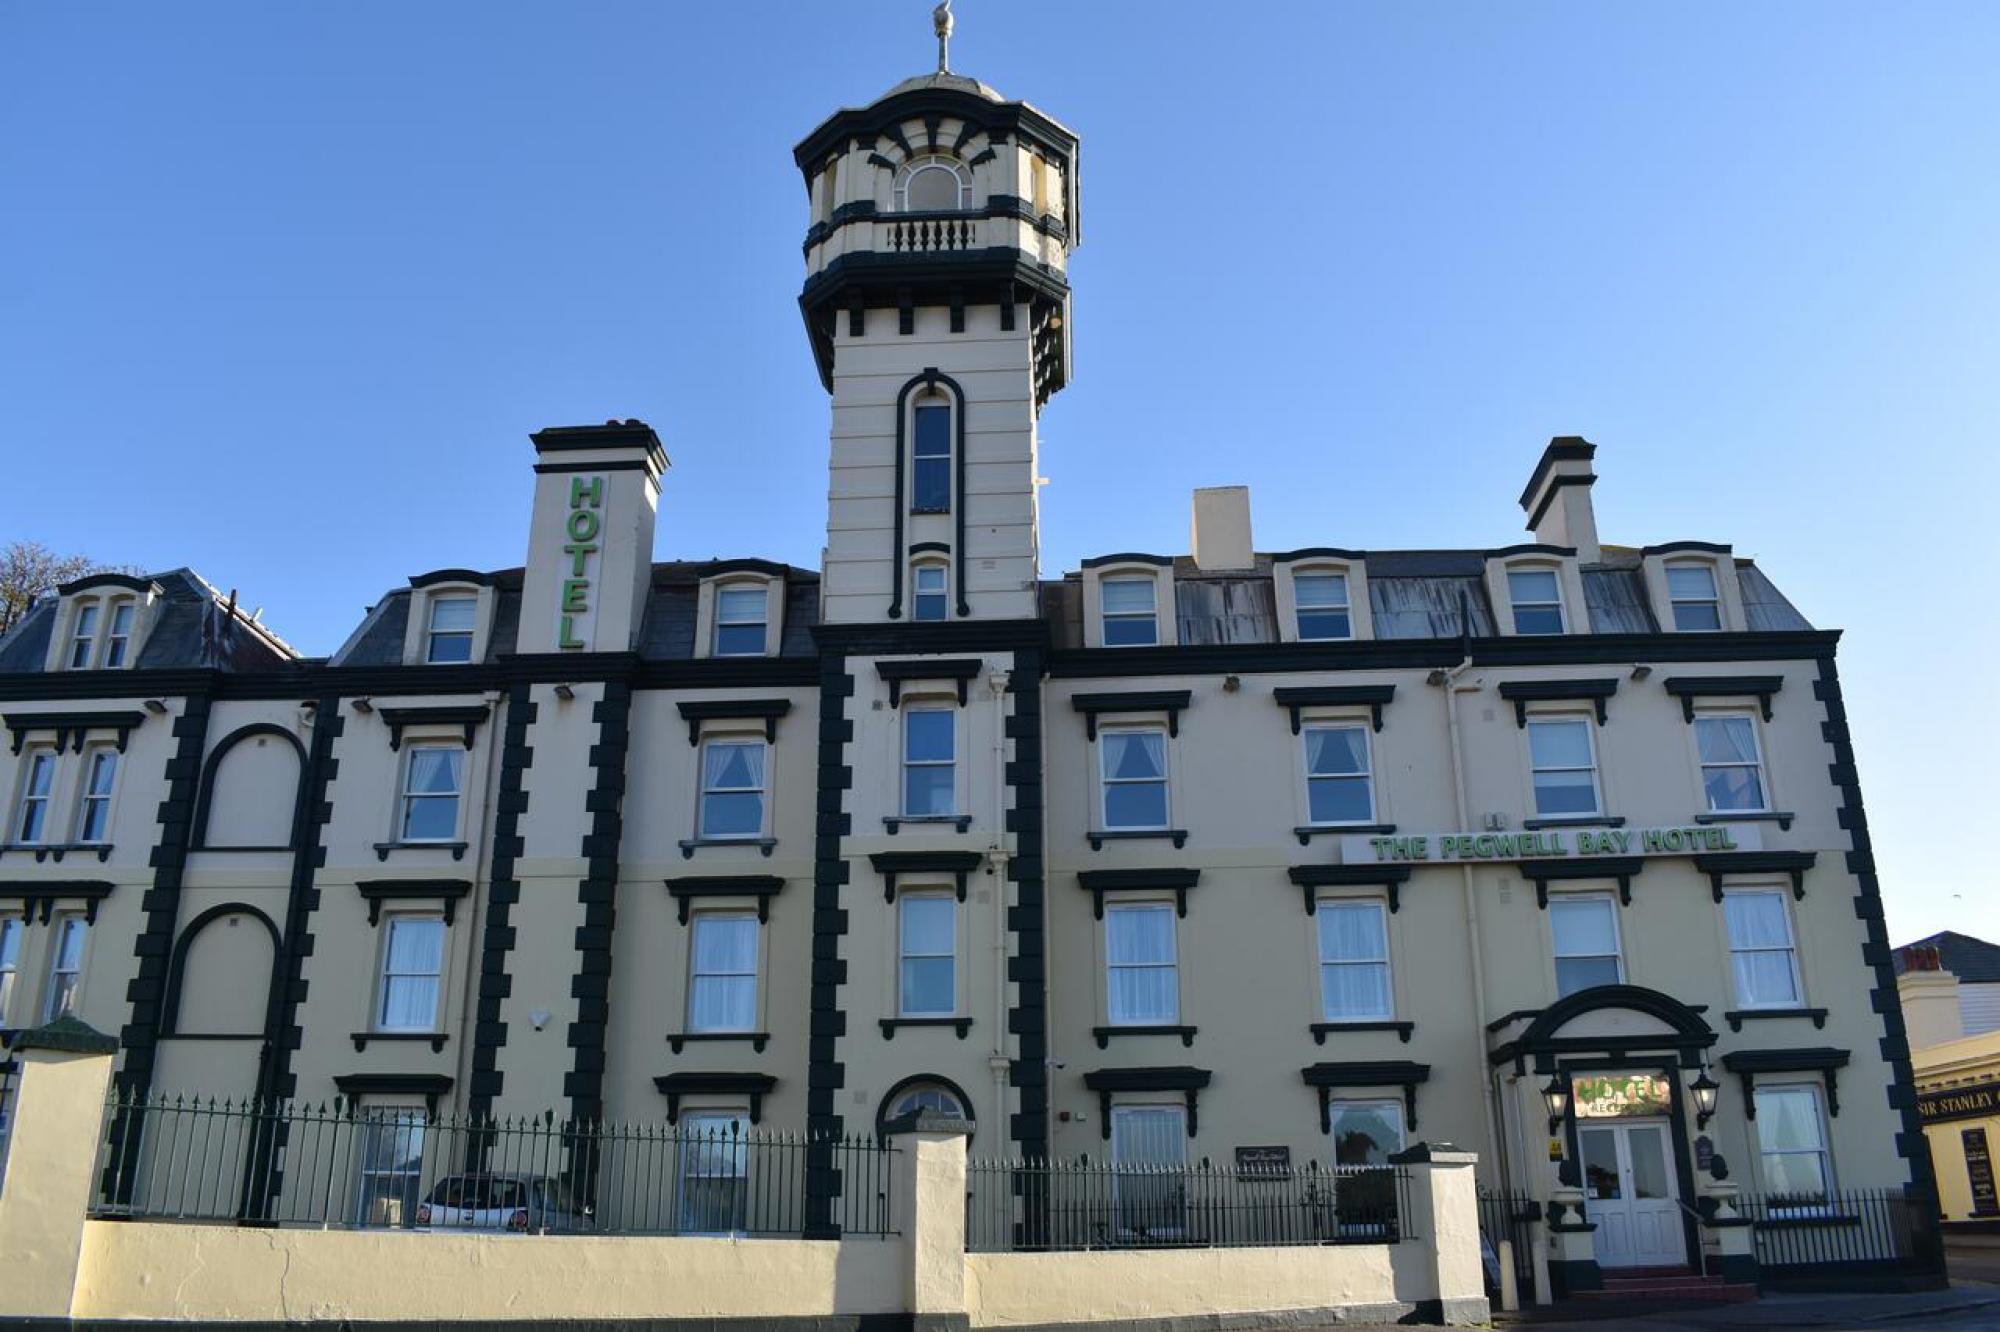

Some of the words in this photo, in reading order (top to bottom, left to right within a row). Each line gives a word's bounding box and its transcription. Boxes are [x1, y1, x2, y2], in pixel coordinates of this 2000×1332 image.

[559, 475, 602, 649] HOTEL
[1370, 837, 1428, 861] THE
[1440, 833, 1567, 859] PEGWELL
[1577, 831, 1631, 855] BAY
[1643, 827, 1738, 853] HOTEL
[1578, 1078, 1663, 1103] HOTEL
[1918, 1101, 1937, 1116] SIR
[1940, 1091, 1993, 1113] STANLEY
